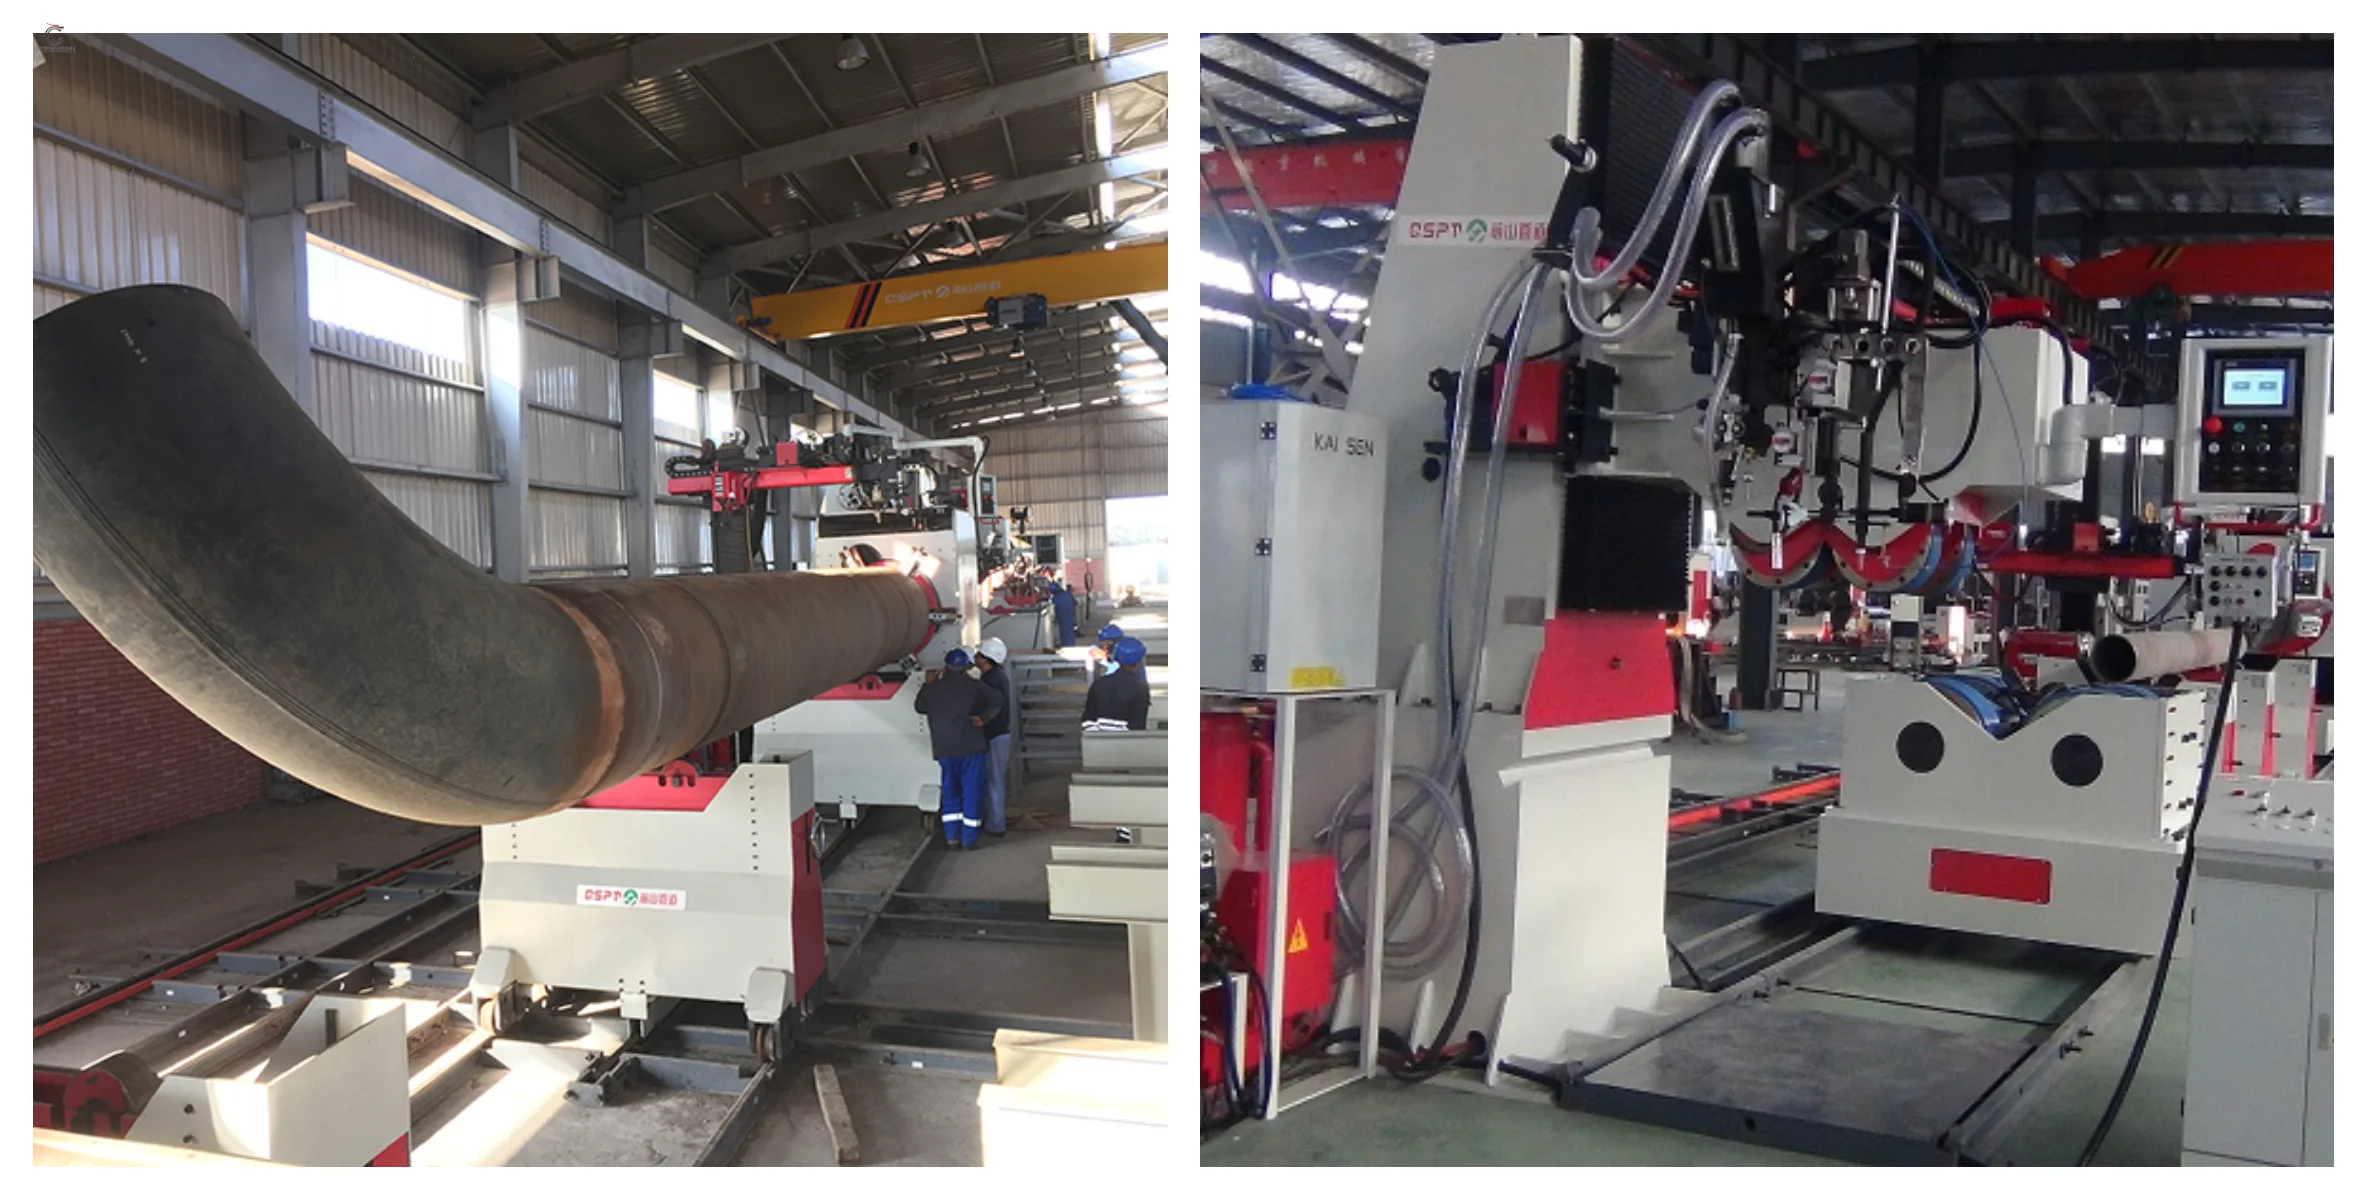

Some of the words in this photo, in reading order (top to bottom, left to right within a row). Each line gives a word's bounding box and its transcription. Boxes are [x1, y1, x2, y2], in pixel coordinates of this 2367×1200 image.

[1410, 222, 1462, 238] CSPT
[885, 289, 933, 304] CSPT
[1314, 431, 1338, 453] KAI
[1346, 436, 1374, 456] SEN
[584, 888, 622, 902] CSPT
